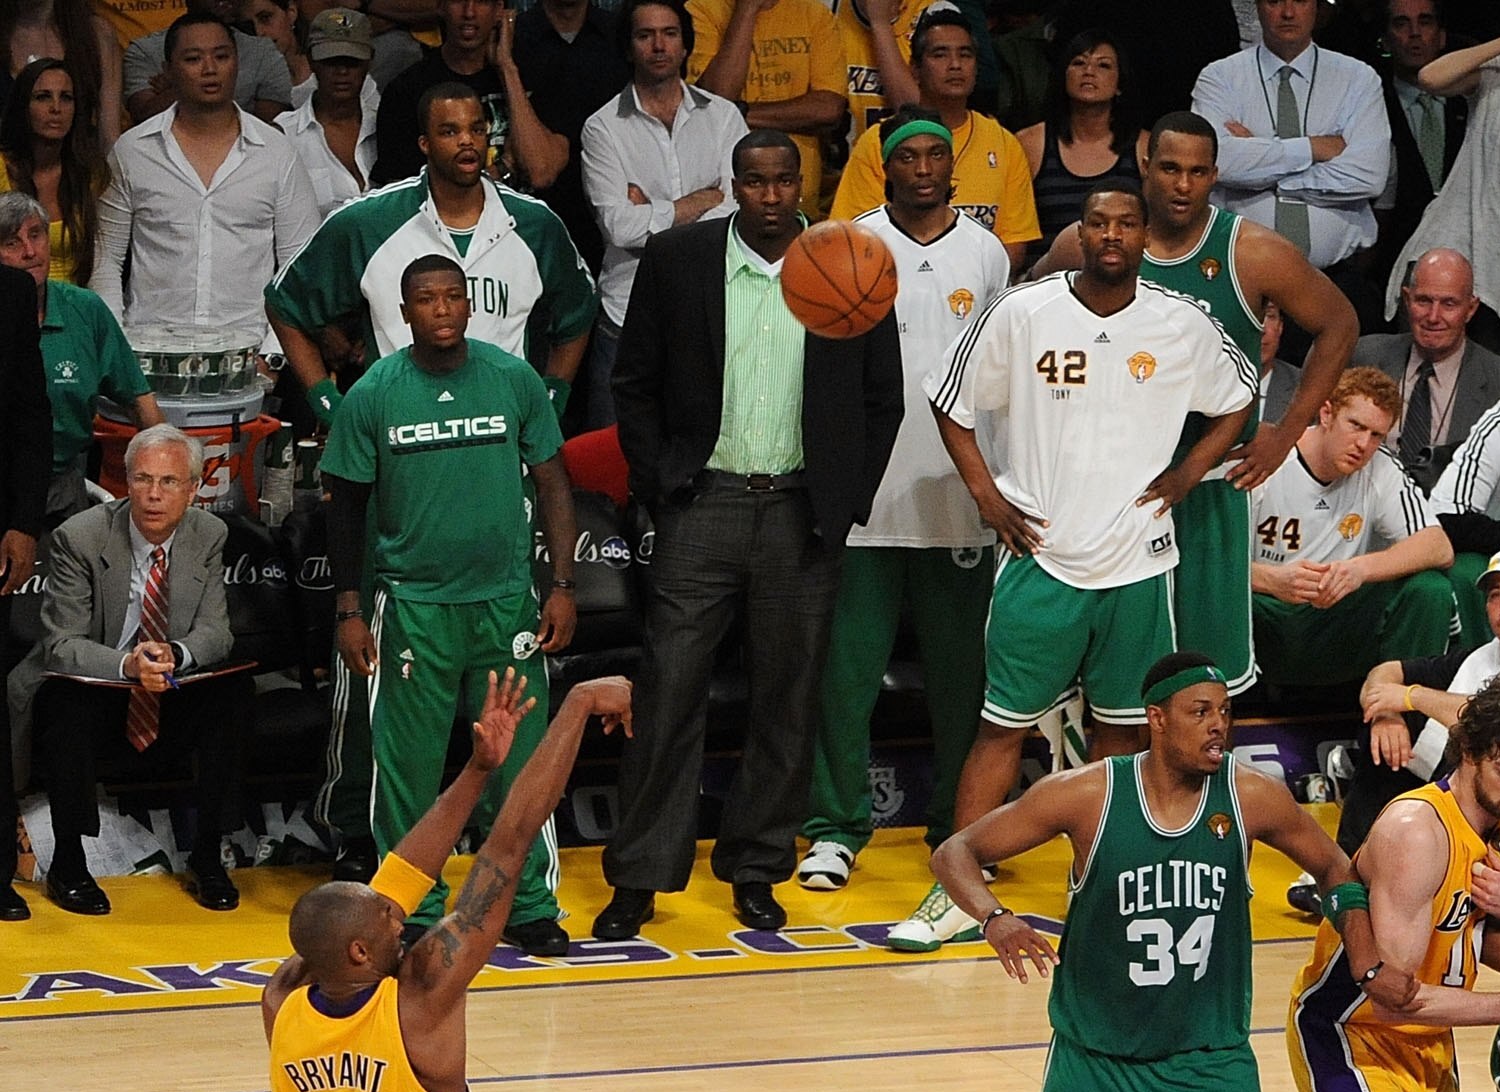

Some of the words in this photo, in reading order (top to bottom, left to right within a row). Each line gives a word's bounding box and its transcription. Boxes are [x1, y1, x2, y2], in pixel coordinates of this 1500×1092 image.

[467, 276, 509, 319] TON
[1035, 349, 1087, 385] 42
[1051, 388, 1071, 400] TONY
[396, 415, 507, 445] CELTICS
[1256, 514, 1301, 551] 44
[600, 545, 631, 560] abc
[1118, 860, 1227, 917] CELTICS
[1125, 913, 1217, 987] 34
